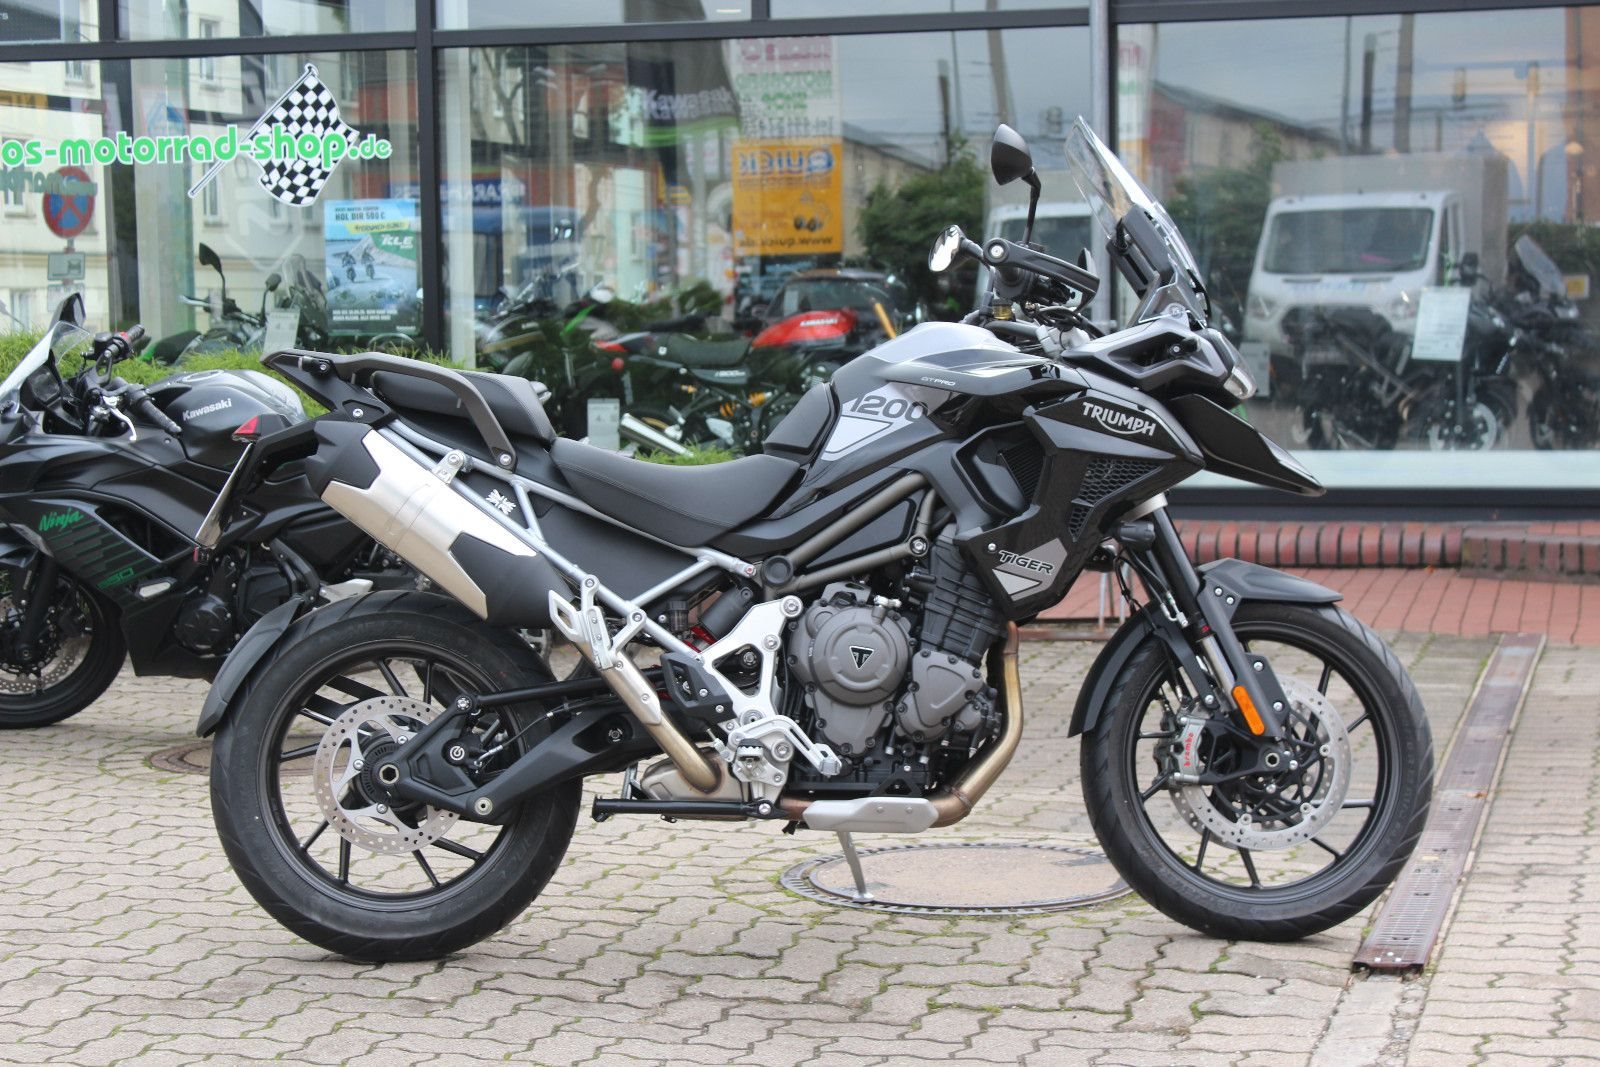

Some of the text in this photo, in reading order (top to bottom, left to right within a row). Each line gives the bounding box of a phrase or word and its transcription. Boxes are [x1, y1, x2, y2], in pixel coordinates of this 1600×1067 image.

[182, 398, 232, 421] Kawasaki
[850, 395, 928, 423] 1200
[1082, 401, 1157, 437] TRIUMPH
[38, 507, 85, 532] Ninja
[999, 550, 1055, 575] TIGER
